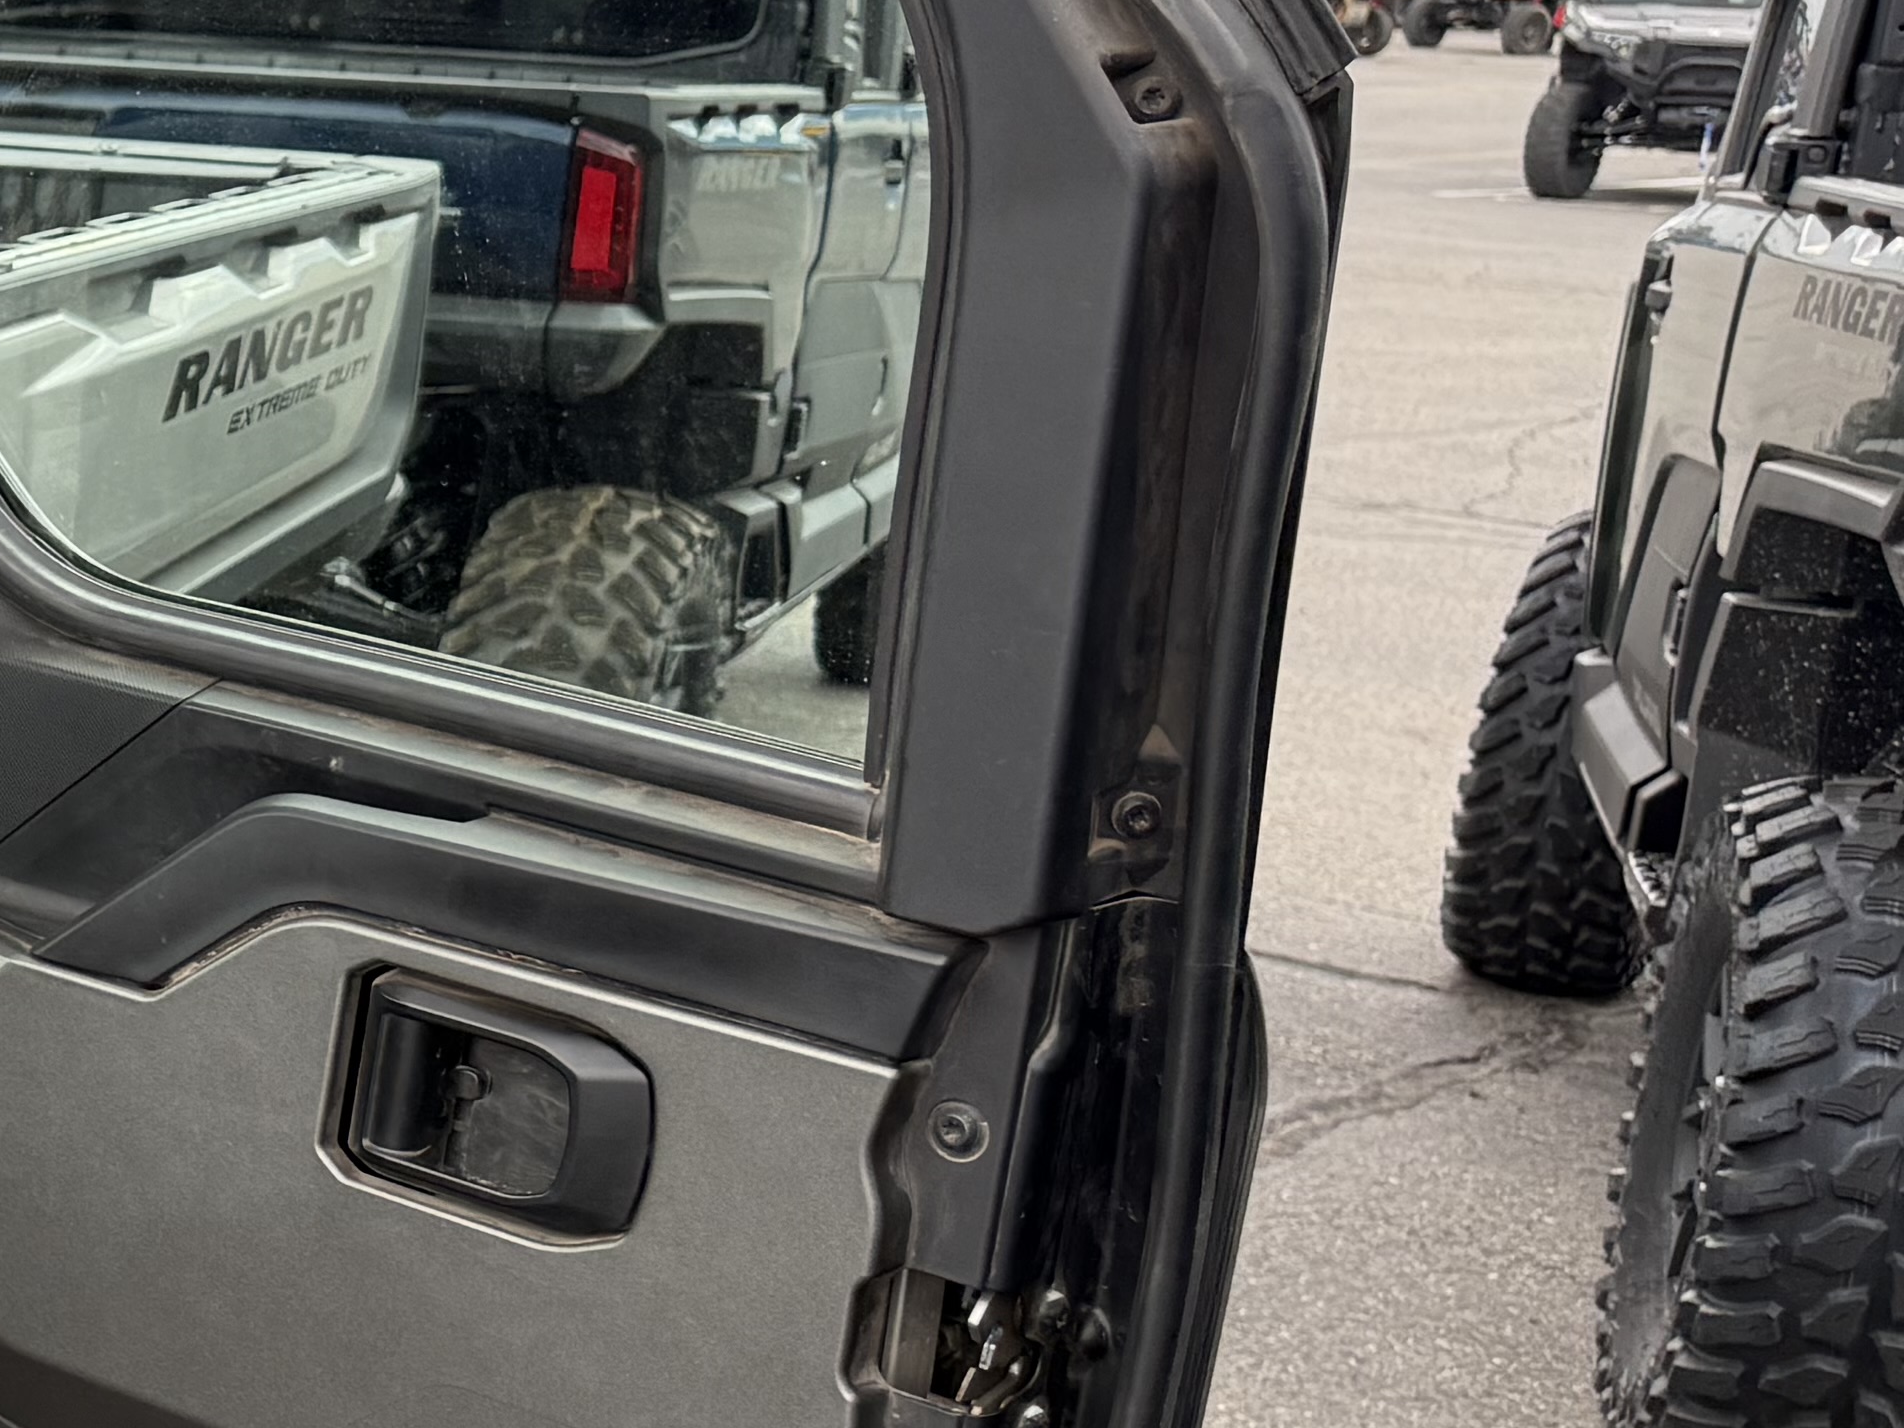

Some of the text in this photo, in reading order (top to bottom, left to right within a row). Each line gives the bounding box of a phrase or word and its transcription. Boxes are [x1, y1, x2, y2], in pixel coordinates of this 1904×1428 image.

[1793, 274, 1904, 346] RANGER
[161, 284, 374, 423] RANGER
[226, 352, 373, 435] EXTREME DUTY
